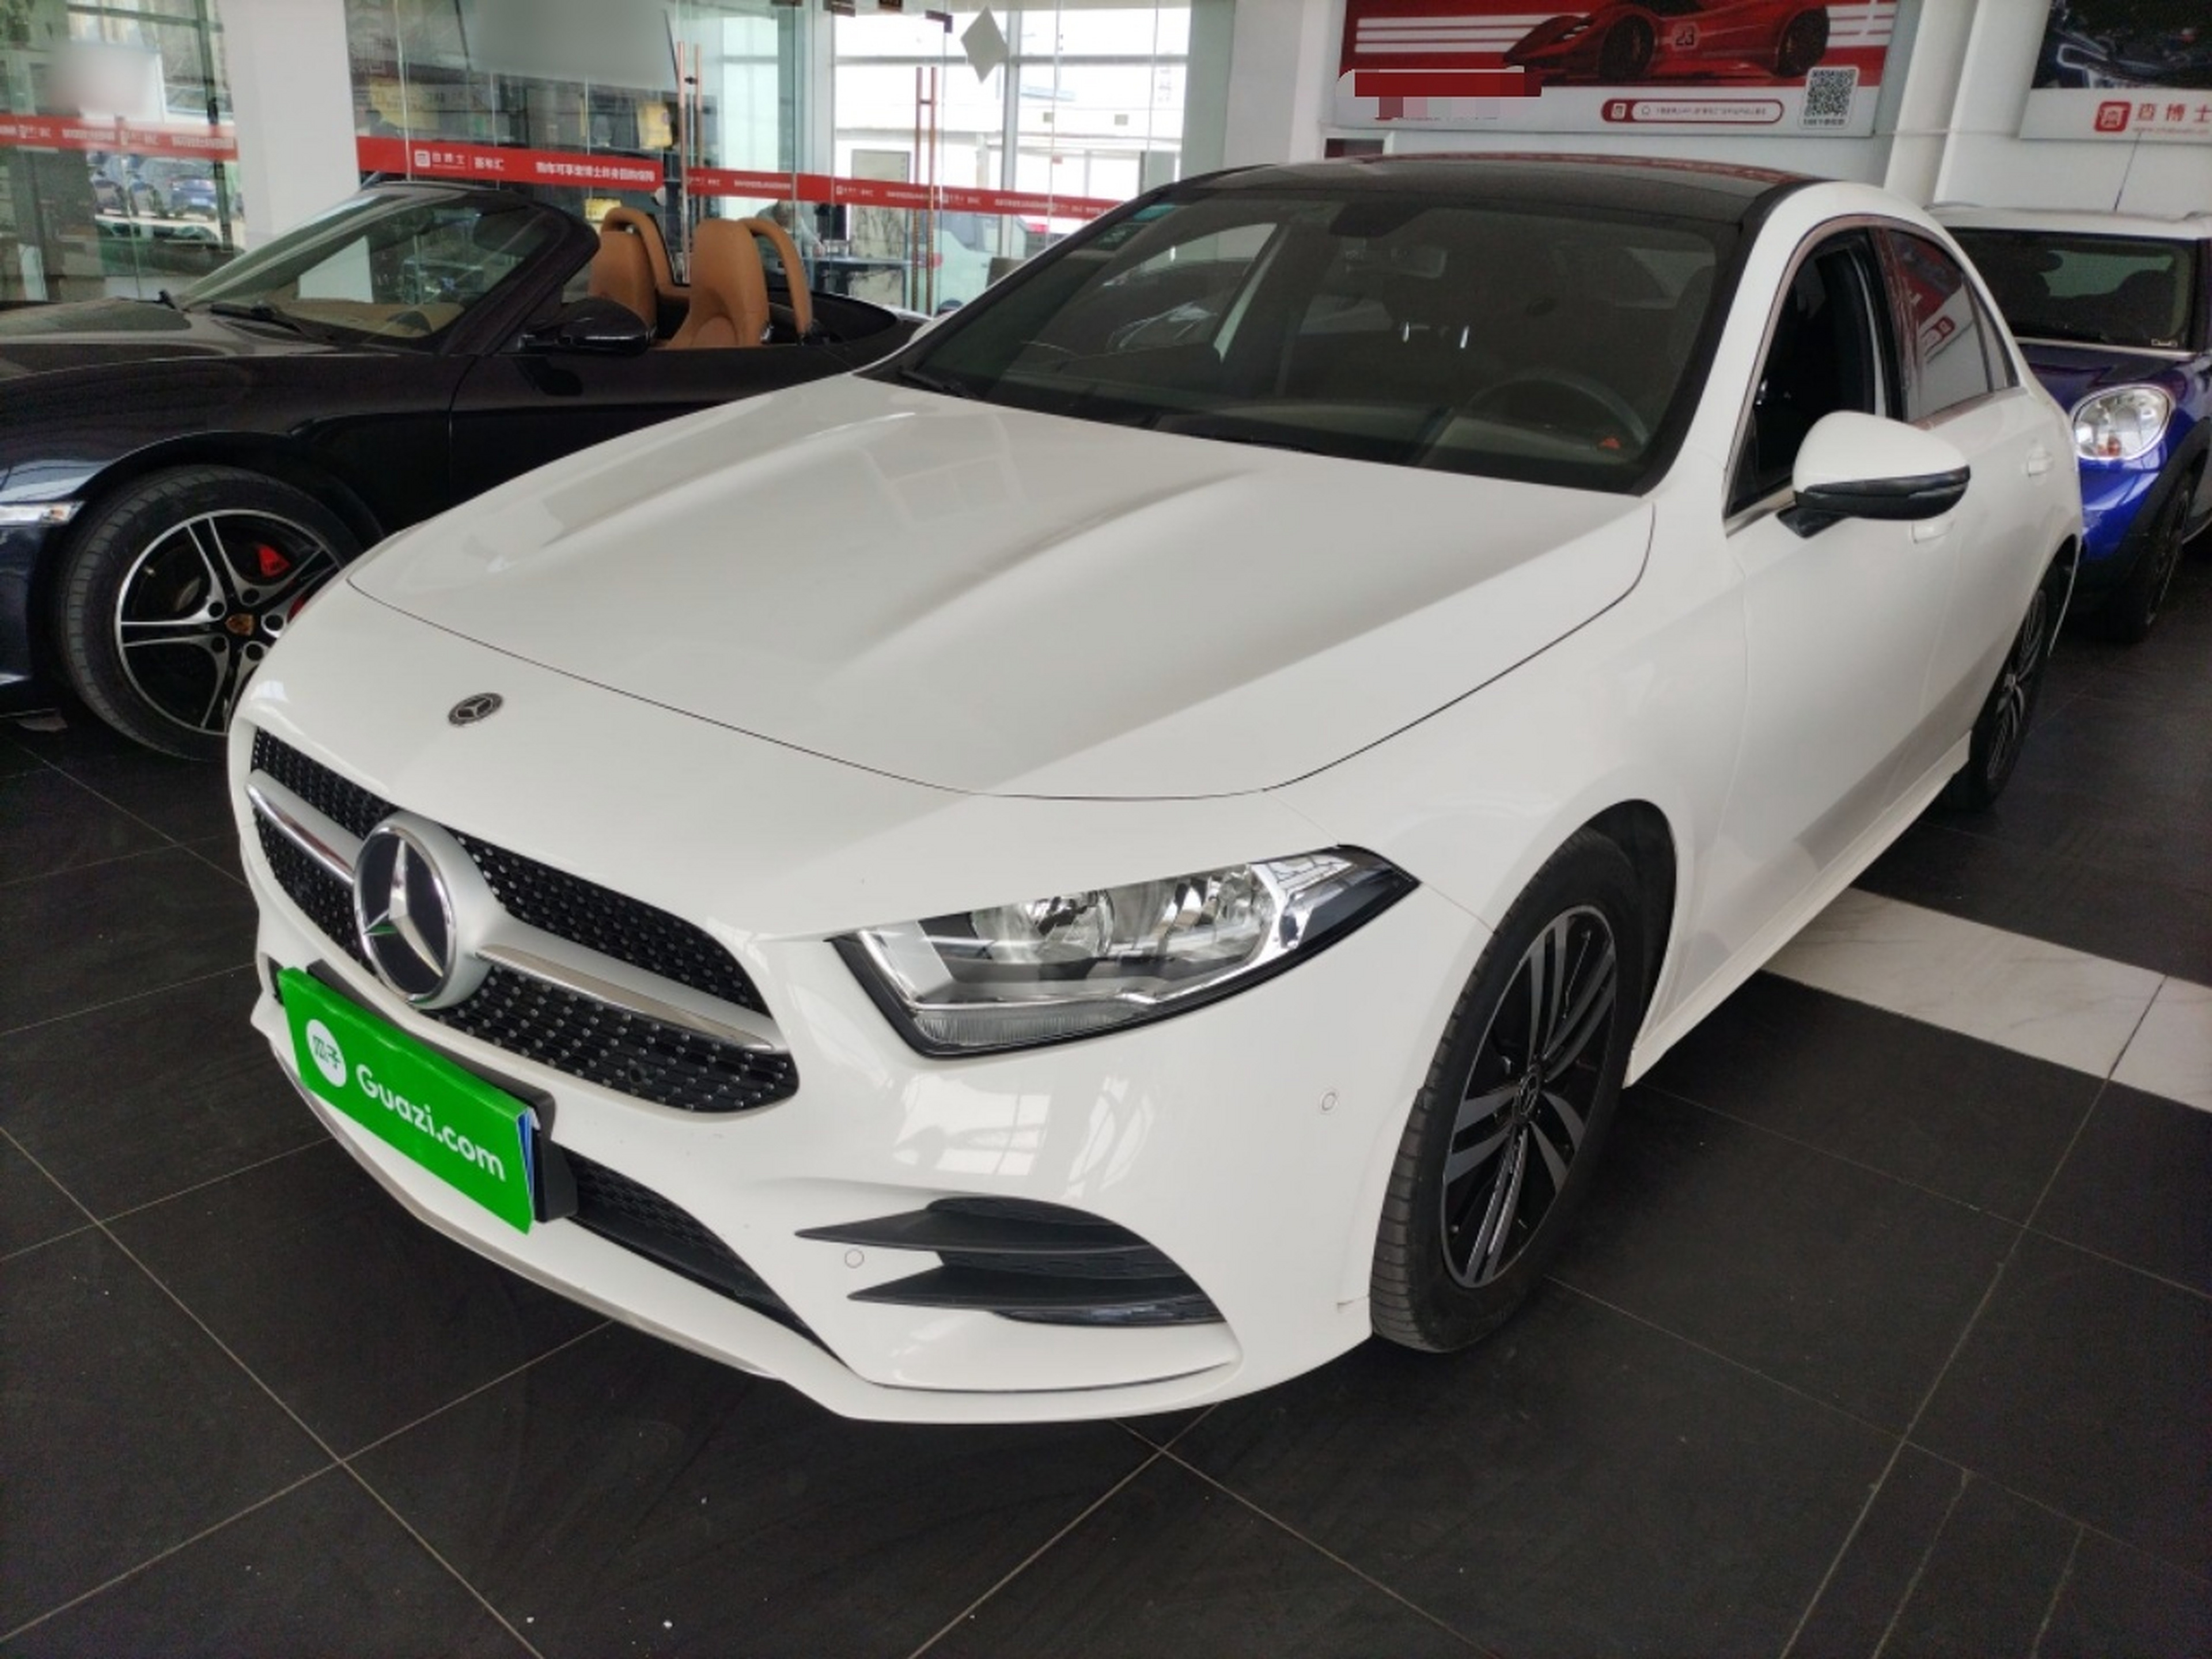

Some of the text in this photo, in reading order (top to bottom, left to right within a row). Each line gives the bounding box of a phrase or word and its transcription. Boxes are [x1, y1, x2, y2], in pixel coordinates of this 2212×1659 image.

[1675, 25, 1695, 46] 23
[312, 1035, 342, 1070] 瓜子
[356, 1064, 507, 1181] Guazi.com
